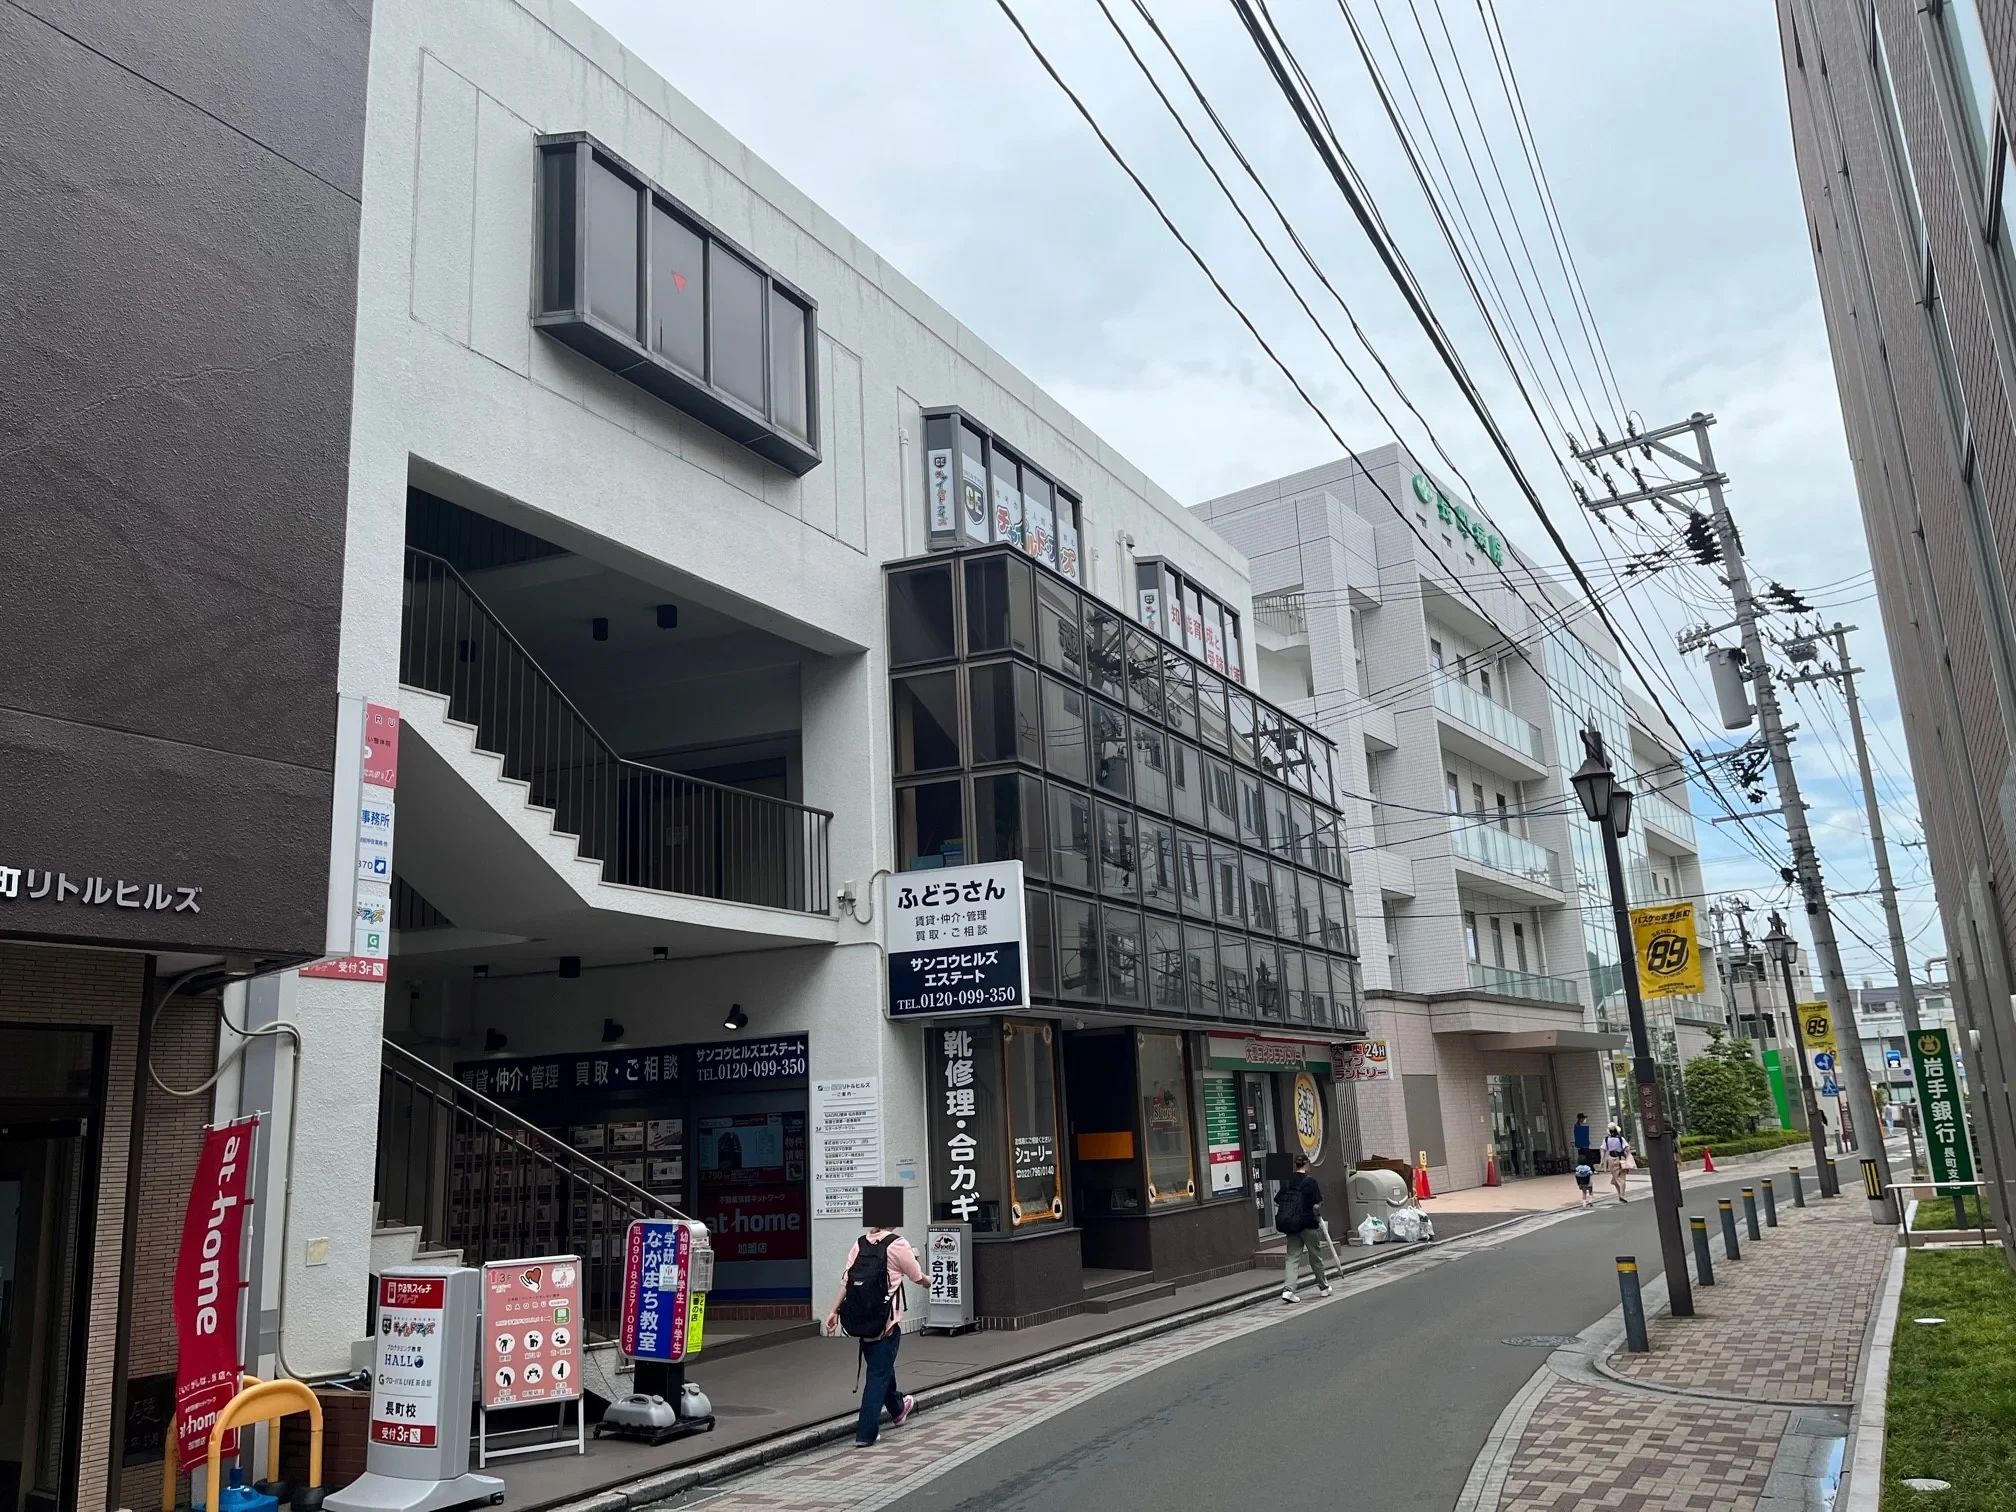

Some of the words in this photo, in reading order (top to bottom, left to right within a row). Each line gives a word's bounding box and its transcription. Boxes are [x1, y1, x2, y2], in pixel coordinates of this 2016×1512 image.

[362, 809, 390, 828] 事務所
[898, 879, 1005, 909] ふどうさん
[916, 910, 987, 928] 賃貸・仲介・管理
[916, 925, 988, 942] 買取・ご相談
[910, 950, 998, 972] サンコウヒルズ
[1648, 937, 1688, 972] 89
[338, 961, 372, 974] 受付3F
[924, 969, 985, 986] エステート
[897, 986, 1016, 1010] TEL.0120-099-350
[1807, 1019, 1828, 1035] 89
[696, 1041, 805, 1062] サンコウヒルズエステート
[1365, 1043, 1386, 1057] 24H
[576, 1054, 678, 1086] 買取・ご相談
[697, 1058, 806, 1081] TEL.0120-099-350
[1334, 1058, 1364, 1068] コイン
[1336, 1068, 1387, 1080] ランドリー
[1924, 1057, 1957, 1144] 岩手銀行
[944, 1030, 980, 1222] 靴修理・合カギ
[1016, 1145, 1052, 1164] シューリー
[731, 1208, 800, 1233] home
[663, 1232, 676, 1265] 学研
[196, 1190, 237, 1336] home
[932, 1260, 944, 1298] 合カギ
[946, 1260, 958, 1298] 靴修理
[638, 1229, 662, 1352] ながまち教室
[386, 1401, 416, 1418] 長町校
[382, 1426, 410, 1442] 受付3F
